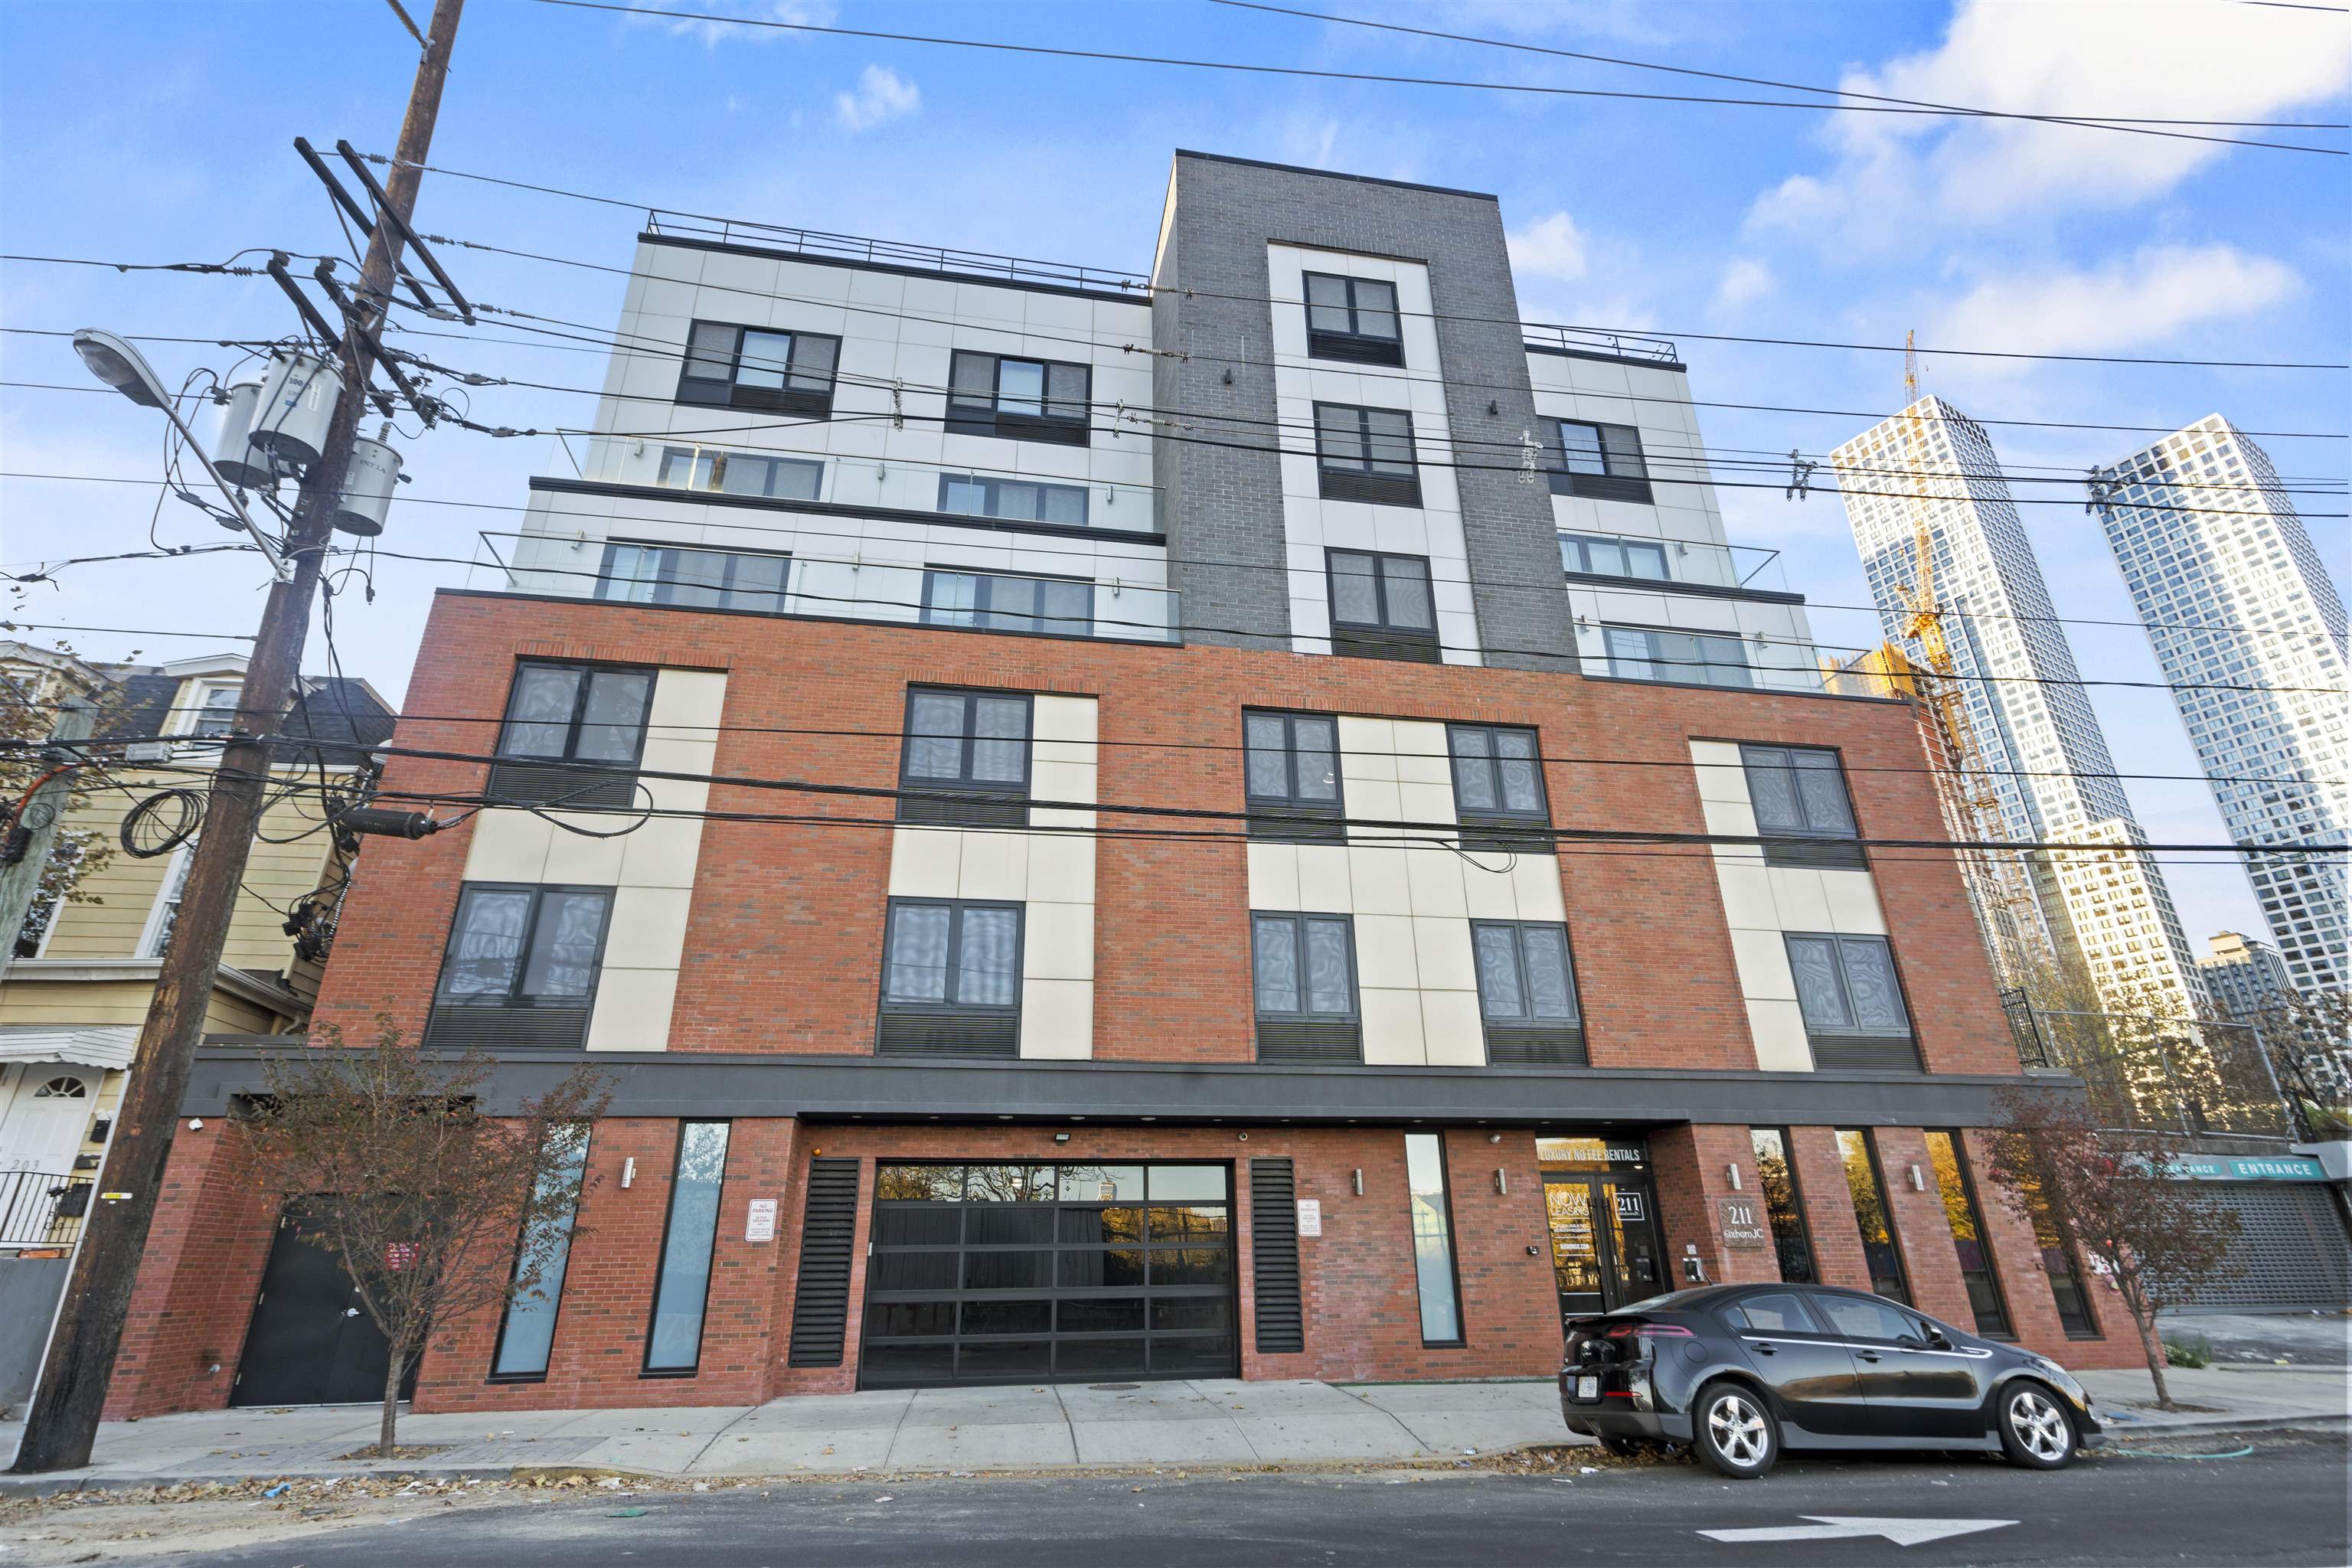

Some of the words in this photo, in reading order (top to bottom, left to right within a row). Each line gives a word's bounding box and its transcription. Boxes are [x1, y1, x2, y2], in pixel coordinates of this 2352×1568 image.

[1540, 1149, 1572, 1161] LUXURY
[1573, 1149, 1586, 1161] NO
[1604, 1149, 1641, 1161] RENTALS
[10, 1159, 40, 1171] 203
[2237, 1163, 2313, 1175] ENTRANCE
[1549, 1192, 1587, 1207] NOW
[1617, 1197, 1639, 1211] 211
[1728, 1206, 1753, 1224] 211
